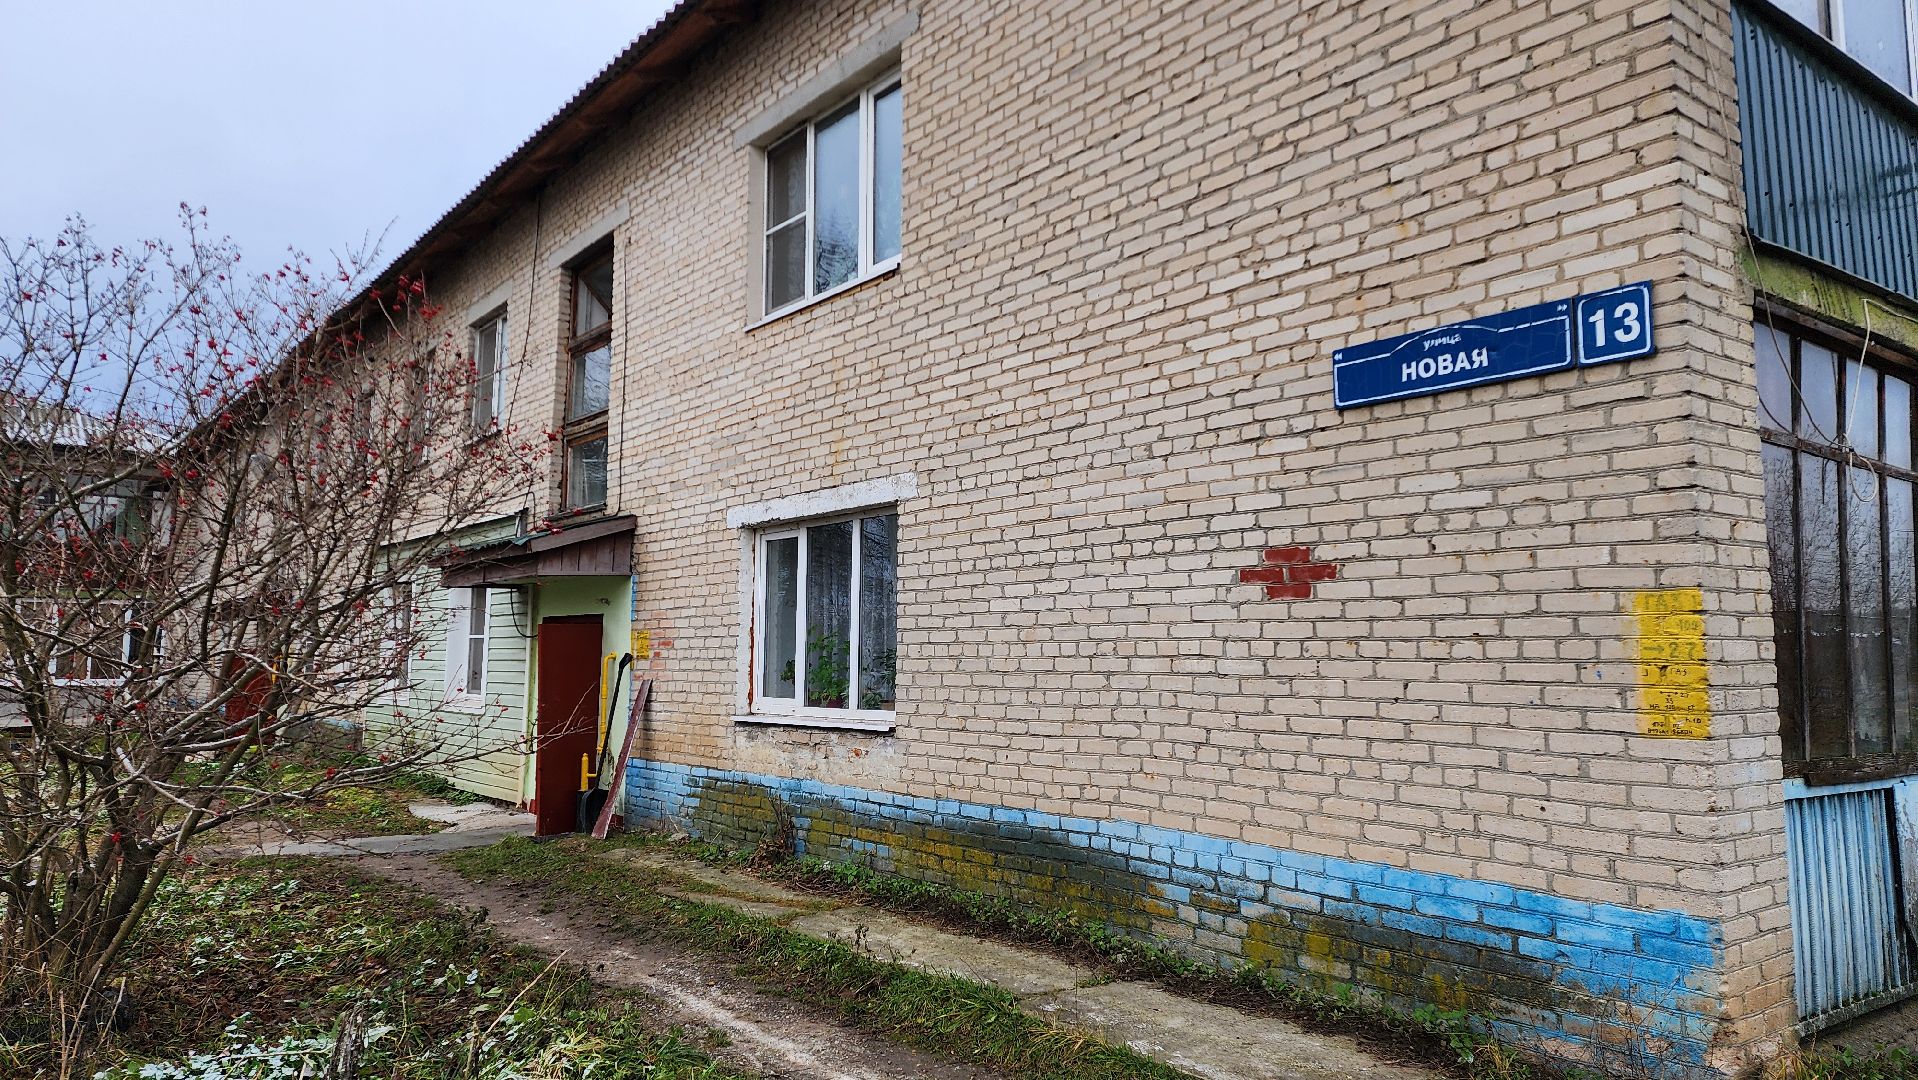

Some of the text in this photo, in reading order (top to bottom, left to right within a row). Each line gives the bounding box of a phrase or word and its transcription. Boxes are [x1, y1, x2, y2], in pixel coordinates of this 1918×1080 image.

[1423, 333, 1462, 351] улица
[1588, 302, 1641, 348] 13
[1401, 346, 1489, 382] НОВАЯ
